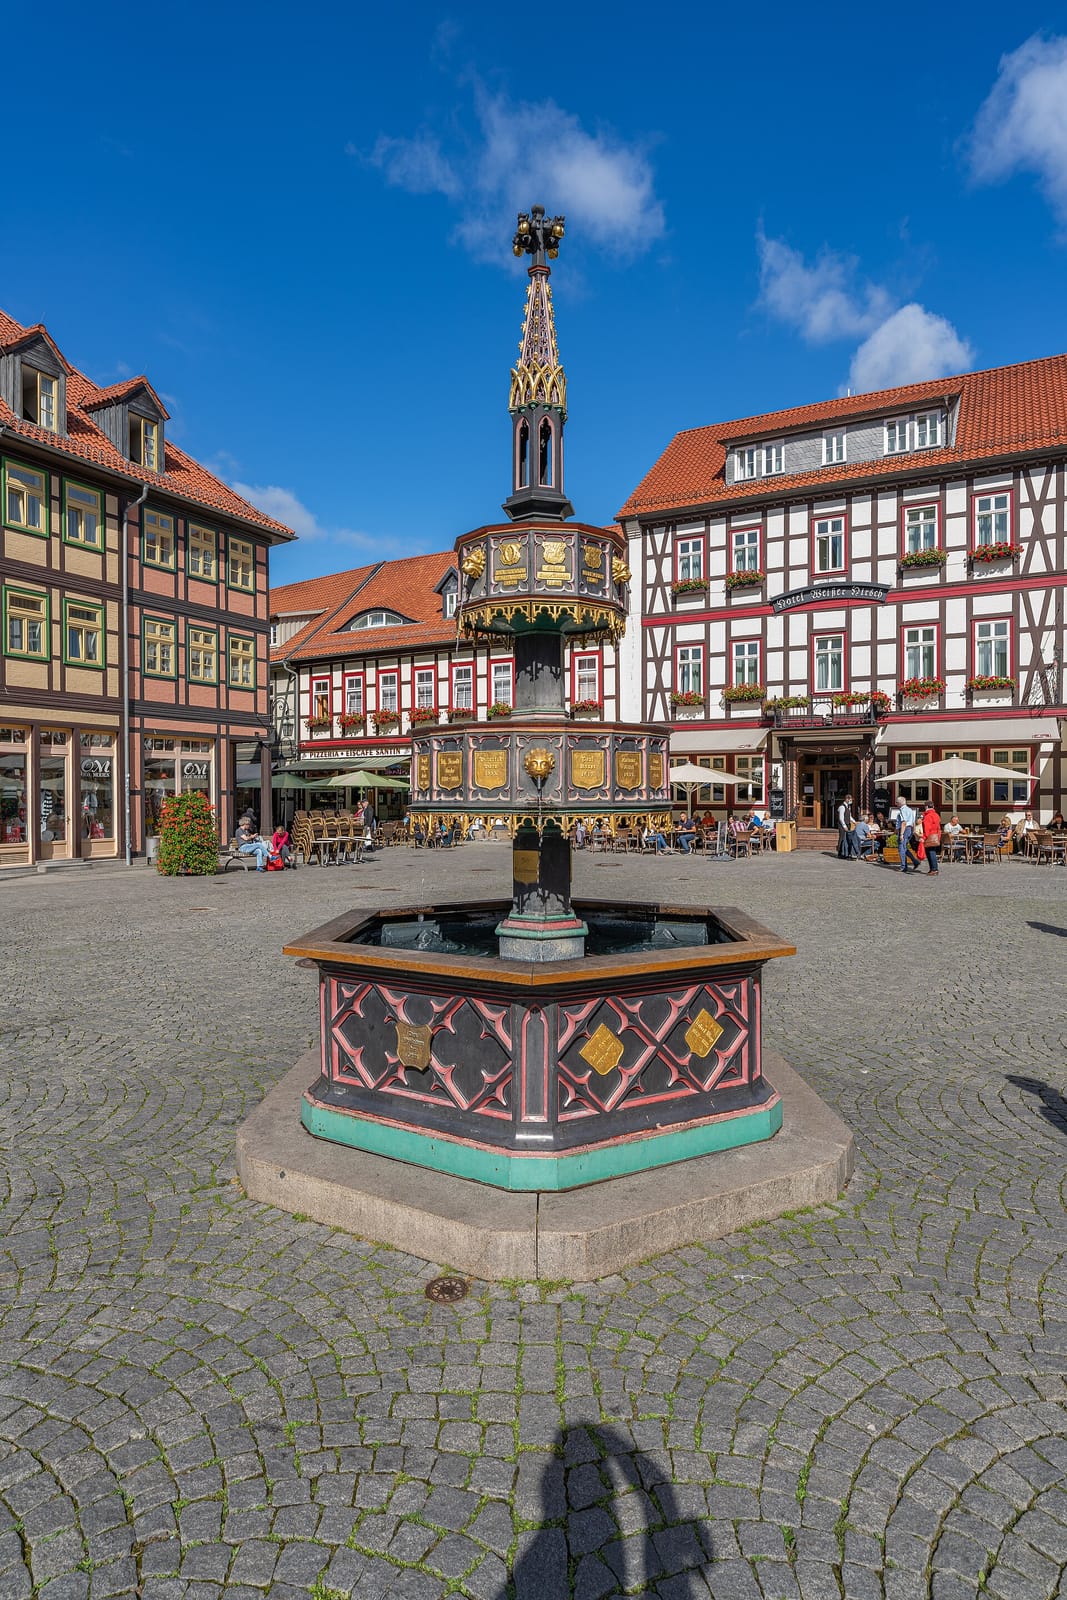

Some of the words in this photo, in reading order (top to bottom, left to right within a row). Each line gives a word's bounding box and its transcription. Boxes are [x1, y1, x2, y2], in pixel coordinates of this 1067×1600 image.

[776, 592, 805, 609] Hotel
[851, 586, 883, 598] Hirsch
[309, 751, 339, 759] PIZZERIA
